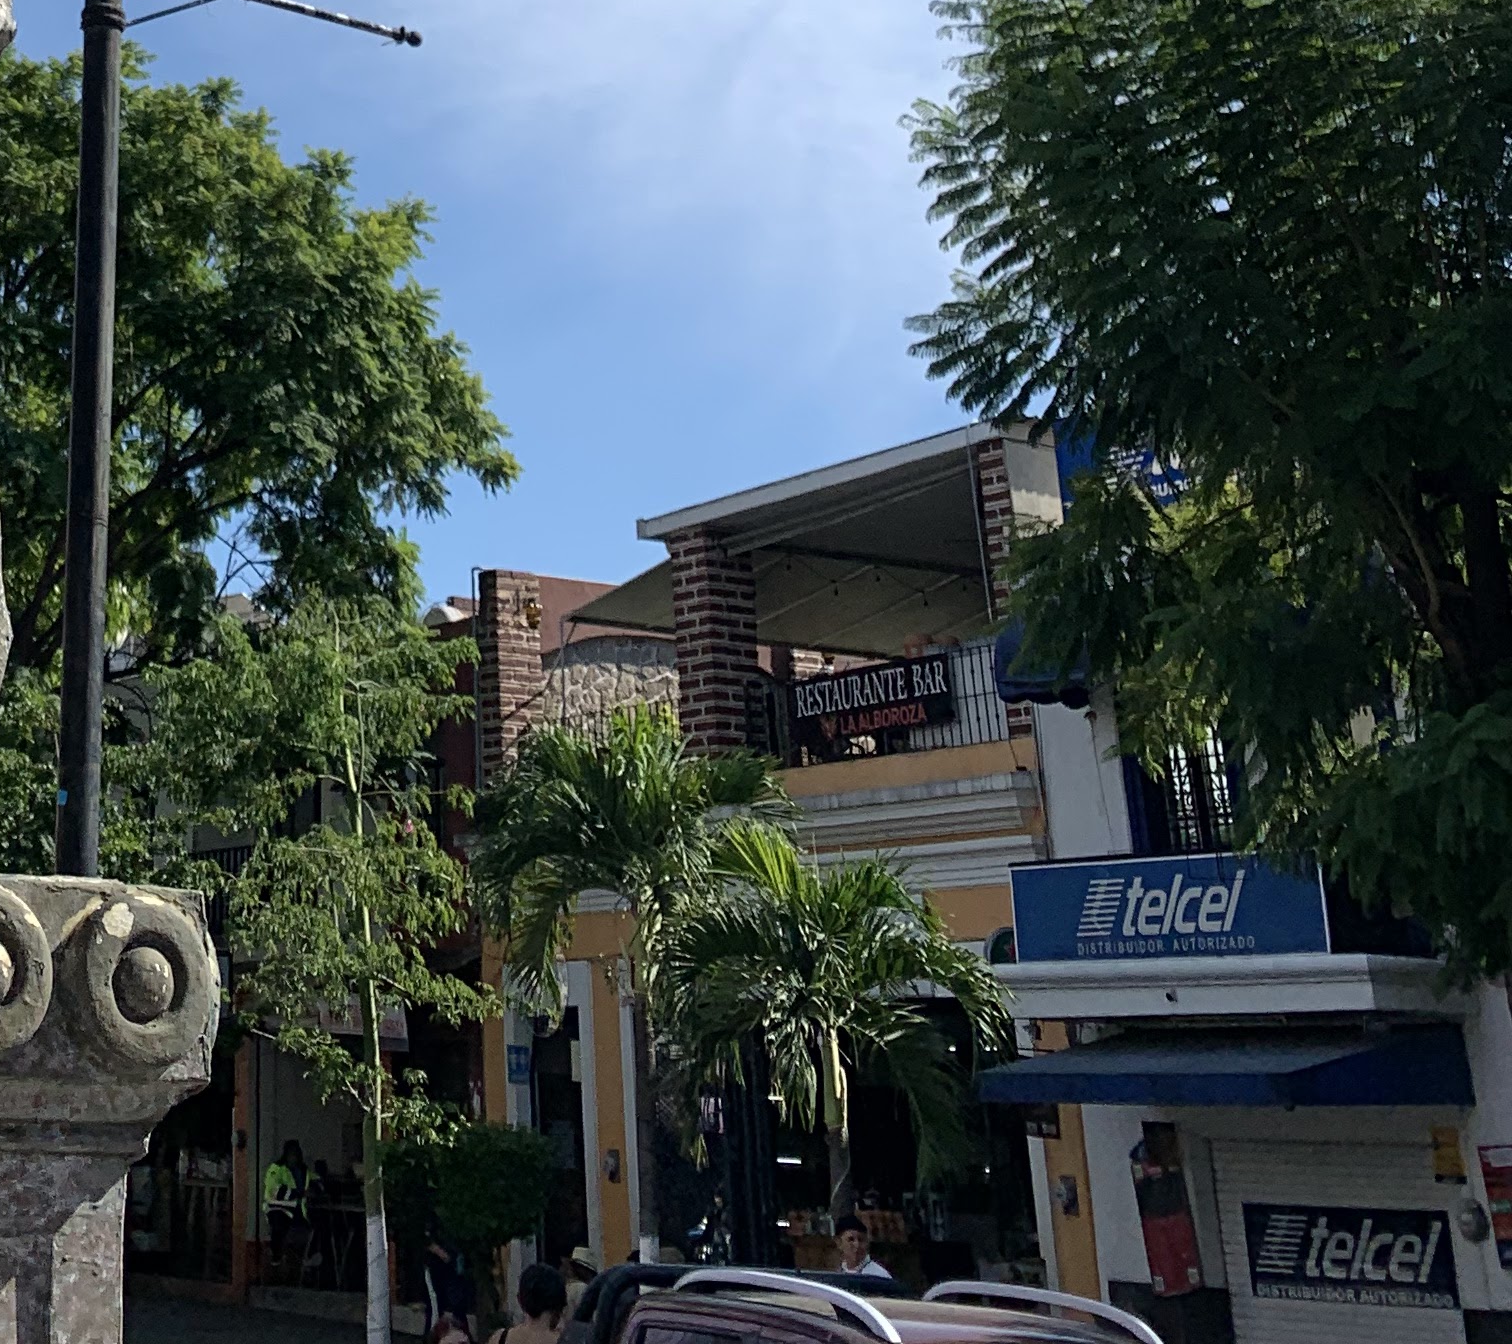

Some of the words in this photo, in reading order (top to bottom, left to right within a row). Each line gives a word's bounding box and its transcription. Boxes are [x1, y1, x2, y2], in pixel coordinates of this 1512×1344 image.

[795, 667, 908, 719] RESTAURANTE
[911, 661, 948, 698] BAR
[839, 714, 857, 735] LA
[1122, 869, 1246, 937] telcel
[1077, 939, 1164, 956] DISTRIBUIDOR
[1172, 935, 1256, 952] AUTORIZADO
[1305, 1215, 1442, 1284] telcel
[1256, 1283, 1356, 1302] DISTRIBUIDOR
[1358, 1289, 1455, 1308] AUTORIZADO
